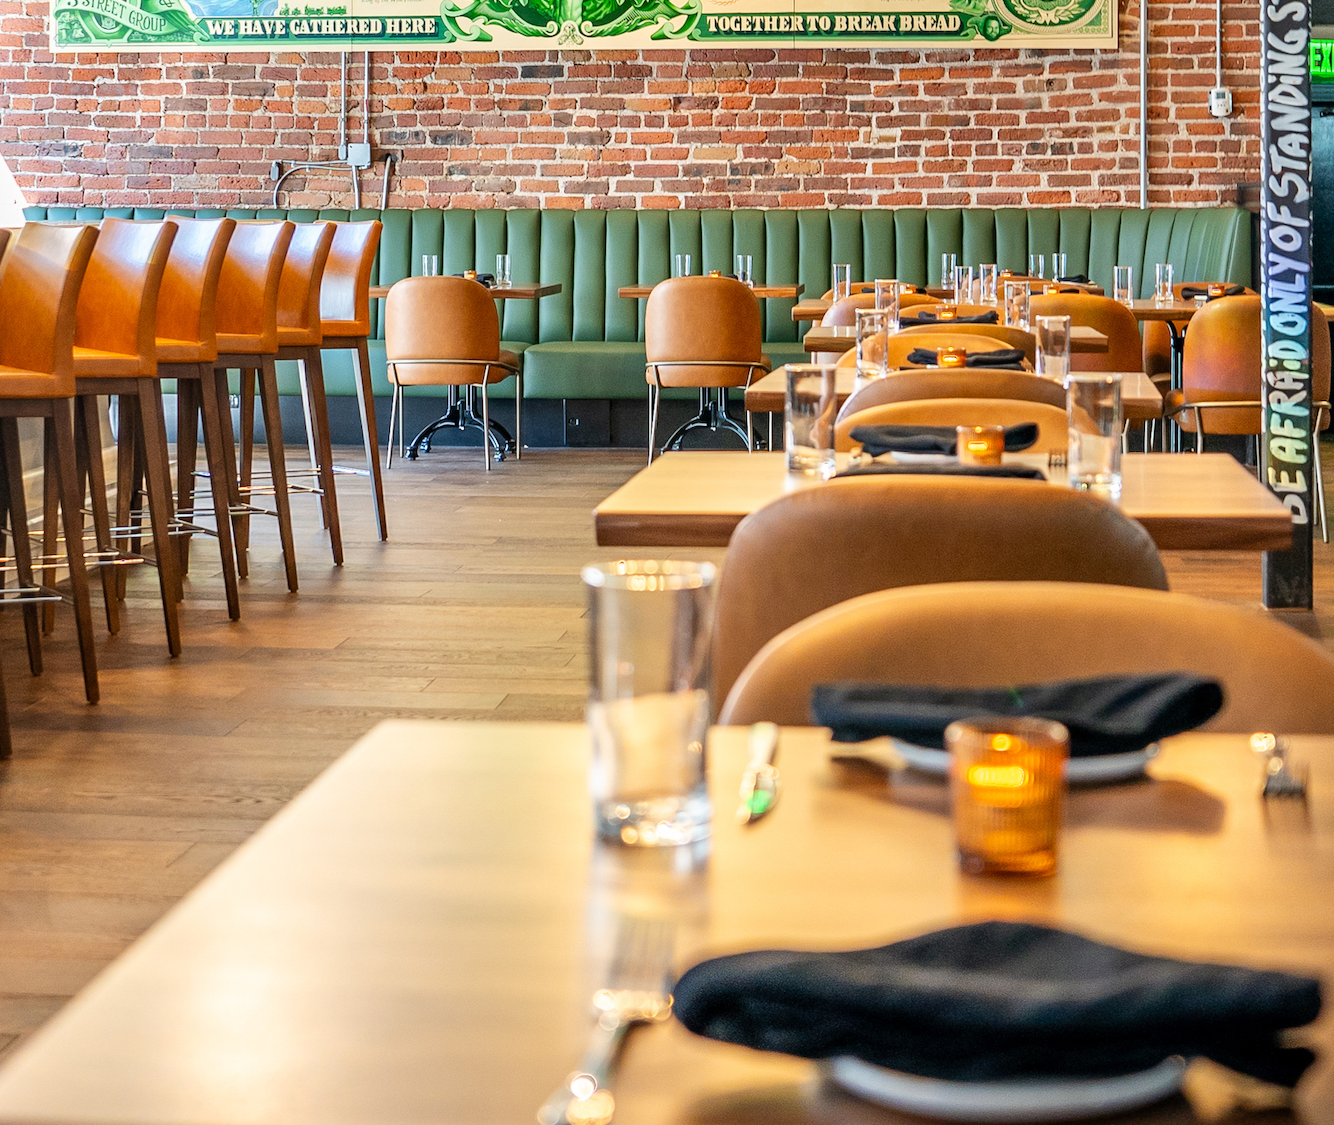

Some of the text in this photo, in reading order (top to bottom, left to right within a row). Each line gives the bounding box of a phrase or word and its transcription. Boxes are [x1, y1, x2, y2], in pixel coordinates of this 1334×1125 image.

[128, 8, 167, 32] GROUP
[206, 18, 437, 35] WE HAVE GATHERED HERE
[707, 15, 961, 32] TOGETHER TO BREAK BREAD
[1267, 33, 1309, 204] STANDING
[1267, 205, 1309, 251] OF
[1267, 252, 1309, 330] ONLY
[1267, 332, 1309, 464] AFRAID
